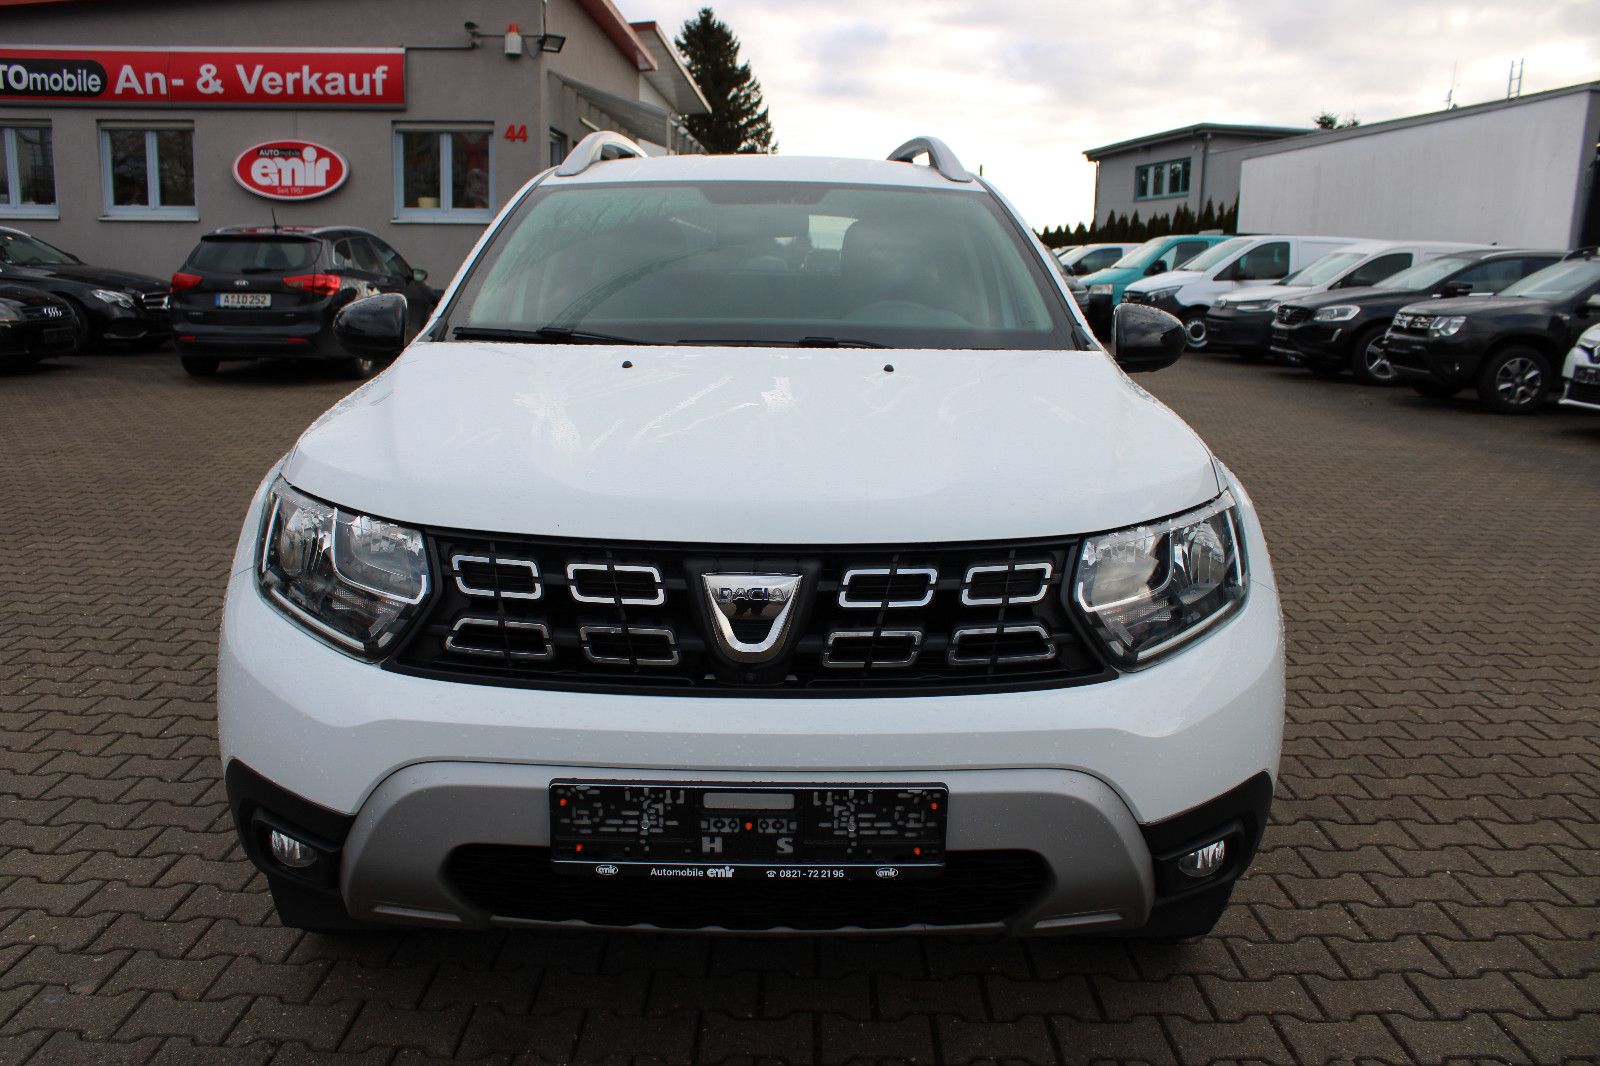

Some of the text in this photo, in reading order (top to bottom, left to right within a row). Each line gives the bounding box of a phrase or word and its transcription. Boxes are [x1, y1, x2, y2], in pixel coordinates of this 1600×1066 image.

[114, 64, 184, 95] An-
[196, 63, 224, 95] &
[235, 63, 389, 96] Verkauf
[504, 123, 528, 143] 44
[251, 146, 330, 187] emir
[719, 587, 786, 601] DACIA
[701, 836, 794, 854] H S
[650, 865, 735, 878] Automobile emir
